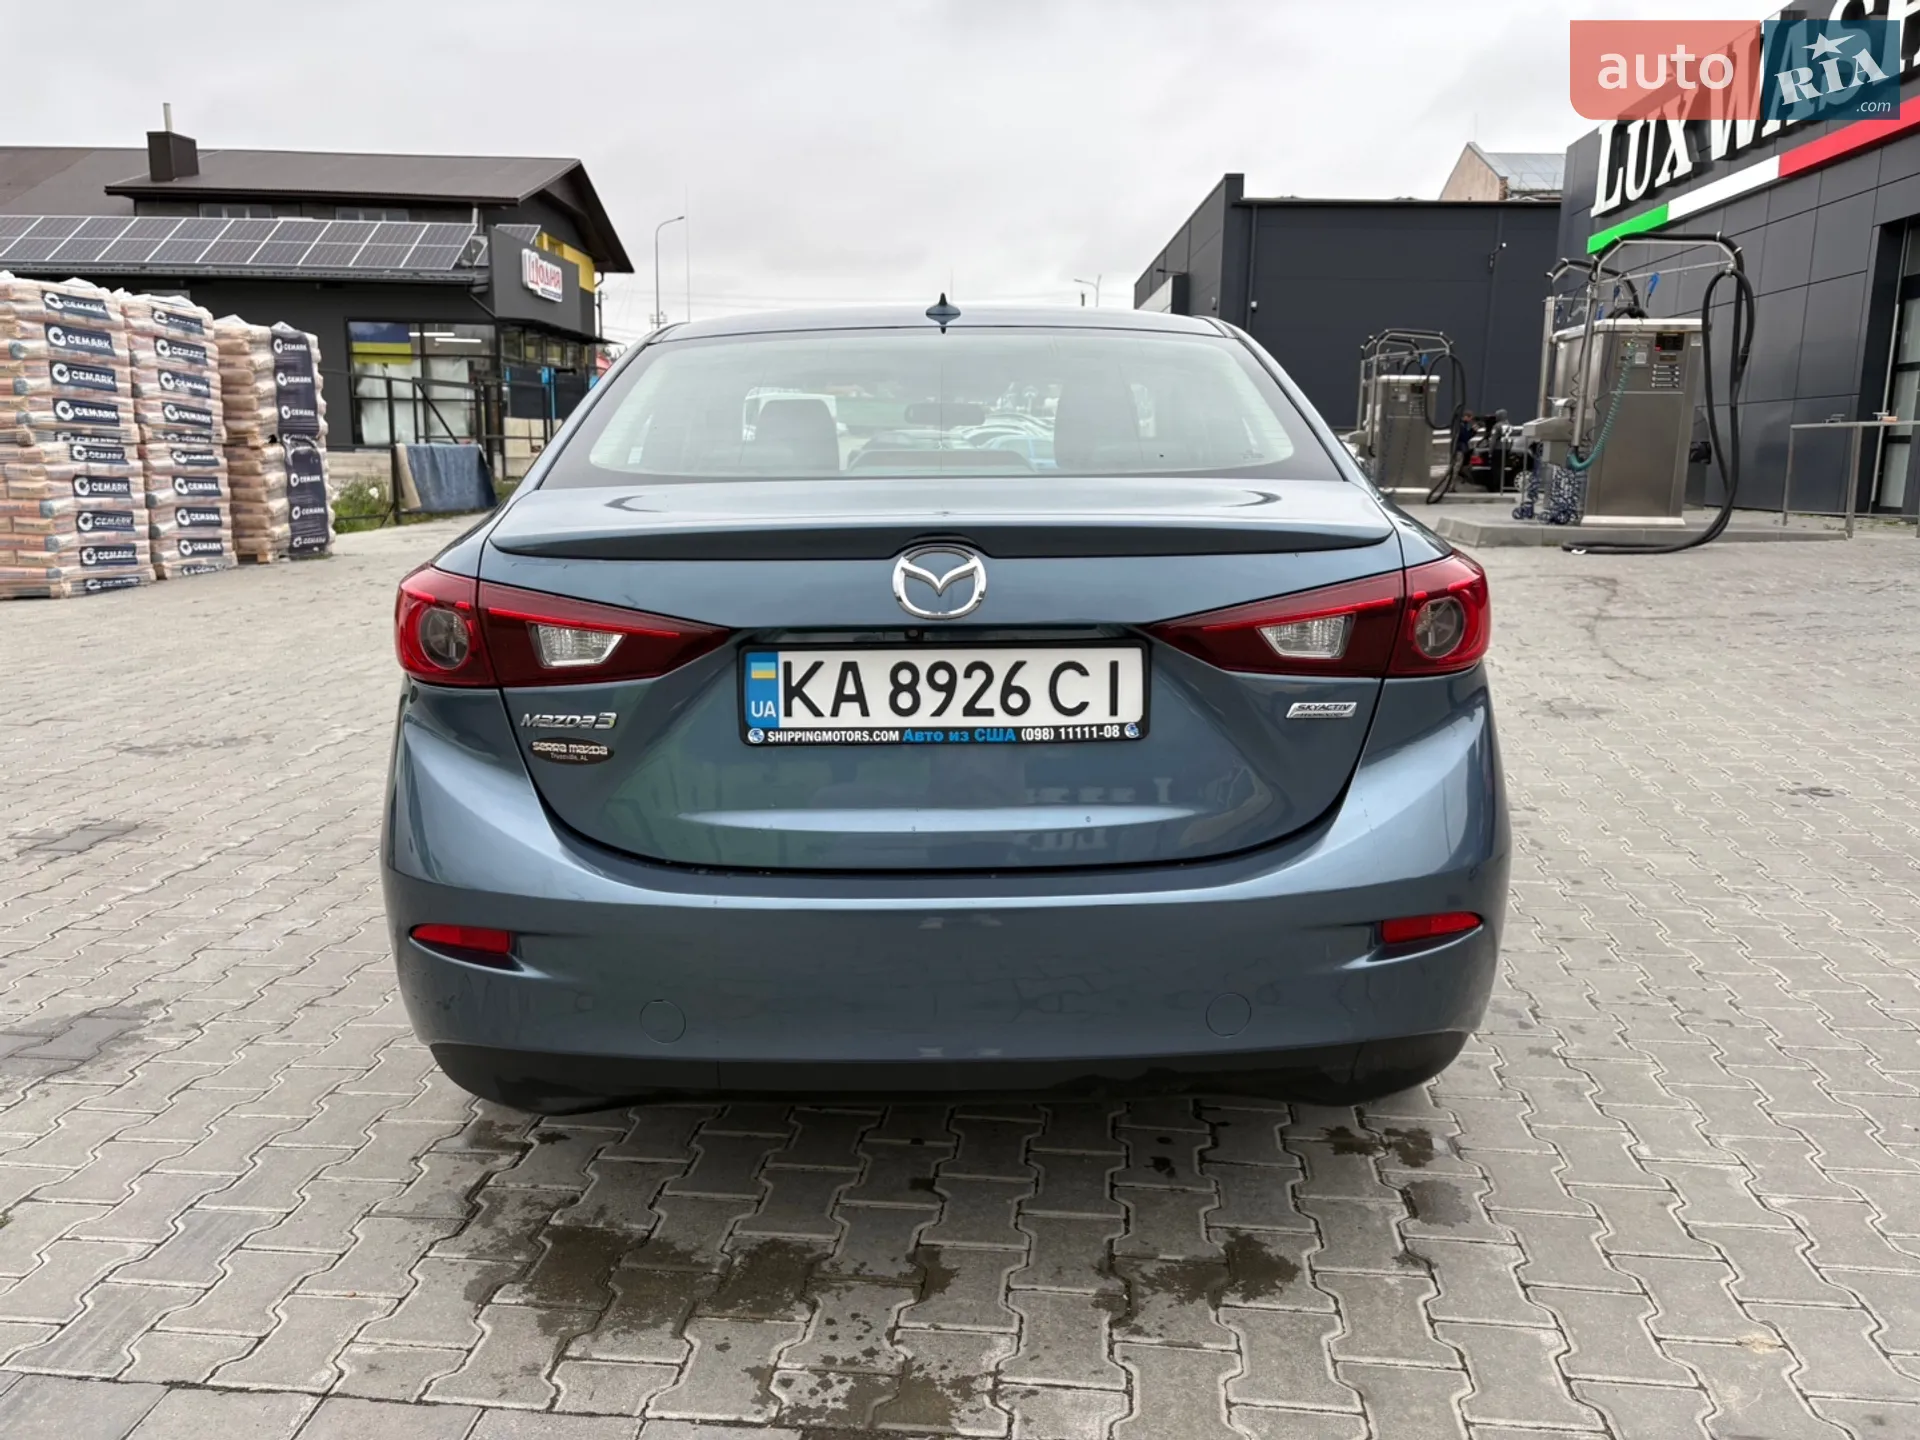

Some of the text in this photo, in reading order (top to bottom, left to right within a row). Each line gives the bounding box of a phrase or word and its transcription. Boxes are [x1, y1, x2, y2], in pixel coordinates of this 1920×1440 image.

[1589, 82, 1700, 218] LUX
[67, 334, 111, 349] CEMARK
[283, 343, 307, 351] CEMARK
[71, 370, 114, 385] CEMARK
[74, 407, 117, 420] CEMARK
[91, 482, 128, 492] CEMARK
[94, 516, 132, 526] CEMARK
[192, 543, 222, 551] CEMARK
[97, 551, 134, 560] CEMARK
[783, 660, 1120, 718] KA 8926 CI
[751, 701, 777, 718] UA
[767, 730, 900, 743] SHIPPINGMOTORS.COM
[948, 732, 970, 742] из
[974, 728, 1016, 743] США
[1021, 727, 1055, 741] (098)
[1059, 724, 1121, 740] 11111-08
